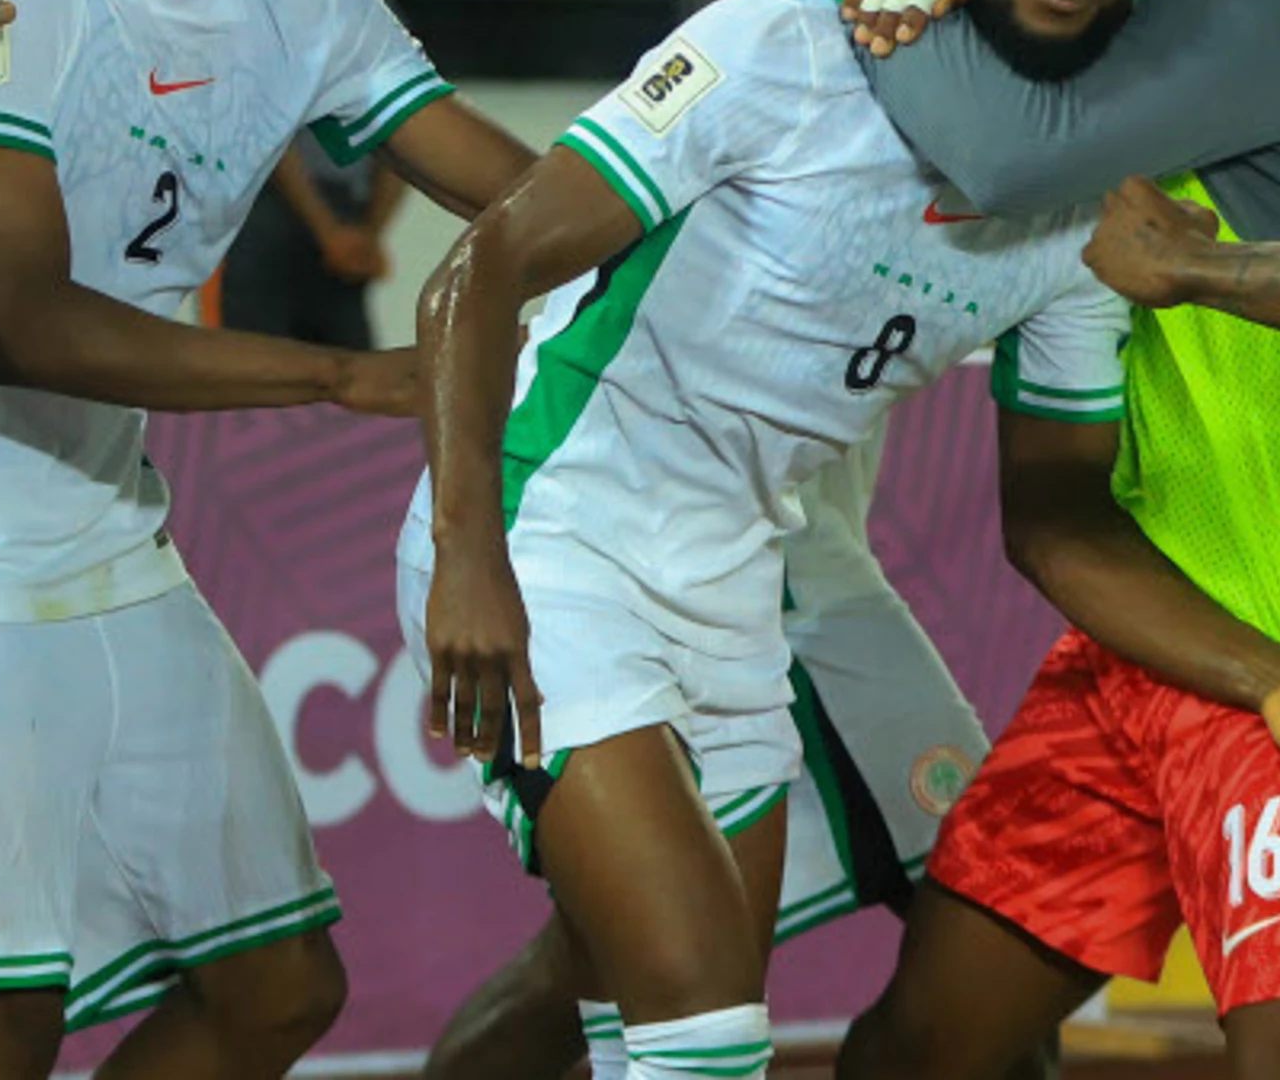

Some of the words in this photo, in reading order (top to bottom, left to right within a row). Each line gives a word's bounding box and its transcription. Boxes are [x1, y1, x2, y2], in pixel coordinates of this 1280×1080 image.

[129, 125, 226, 172] NAJA
[124, 170, 180, 266] 2
[872, 262, 979, 316] NAIJA
[844, 314, 916, 396] 8
